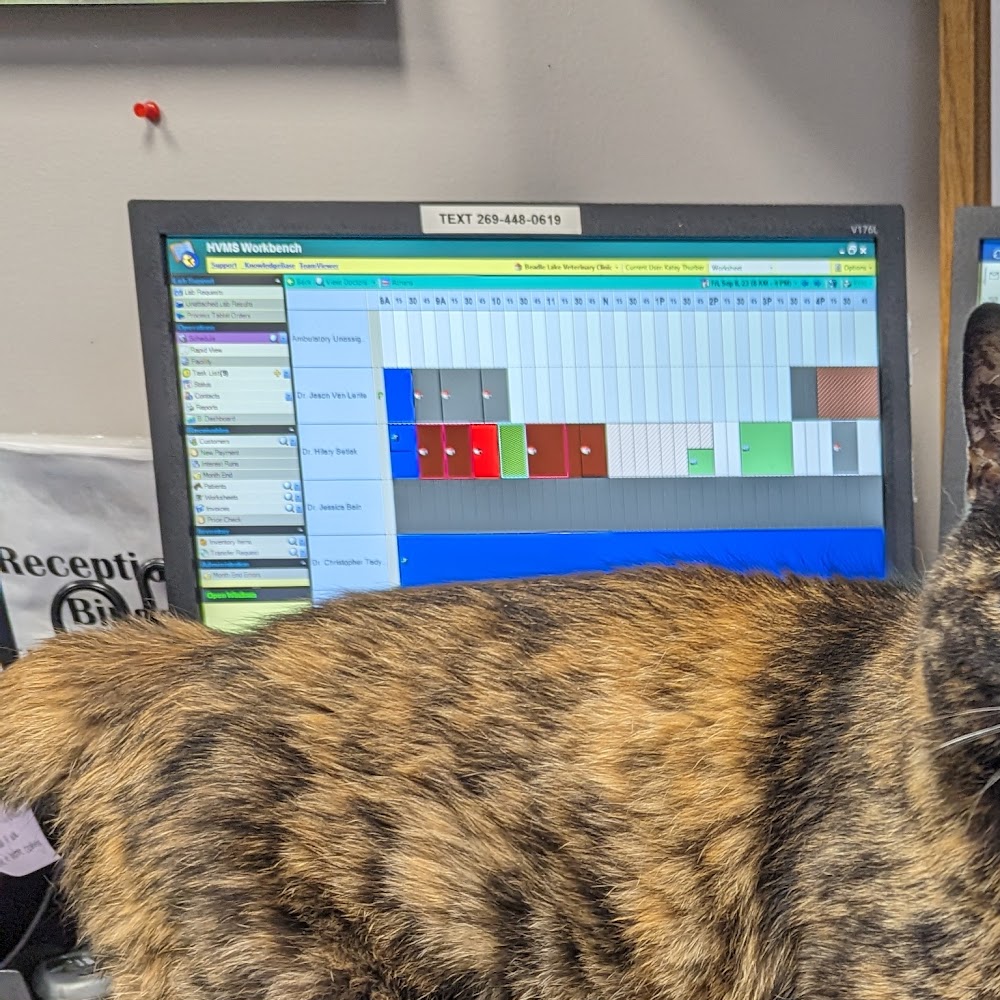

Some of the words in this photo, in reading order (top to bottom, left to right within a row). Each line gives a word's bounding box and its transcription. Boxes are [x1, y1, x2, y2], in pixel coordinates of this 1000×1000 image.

[439, 214, 472, 225] TEXT
[477, 214, 561, 226] 269-448-0619
[206, 242, 239, 253] HVMS
[241, 243, 303, 253] Workbench
